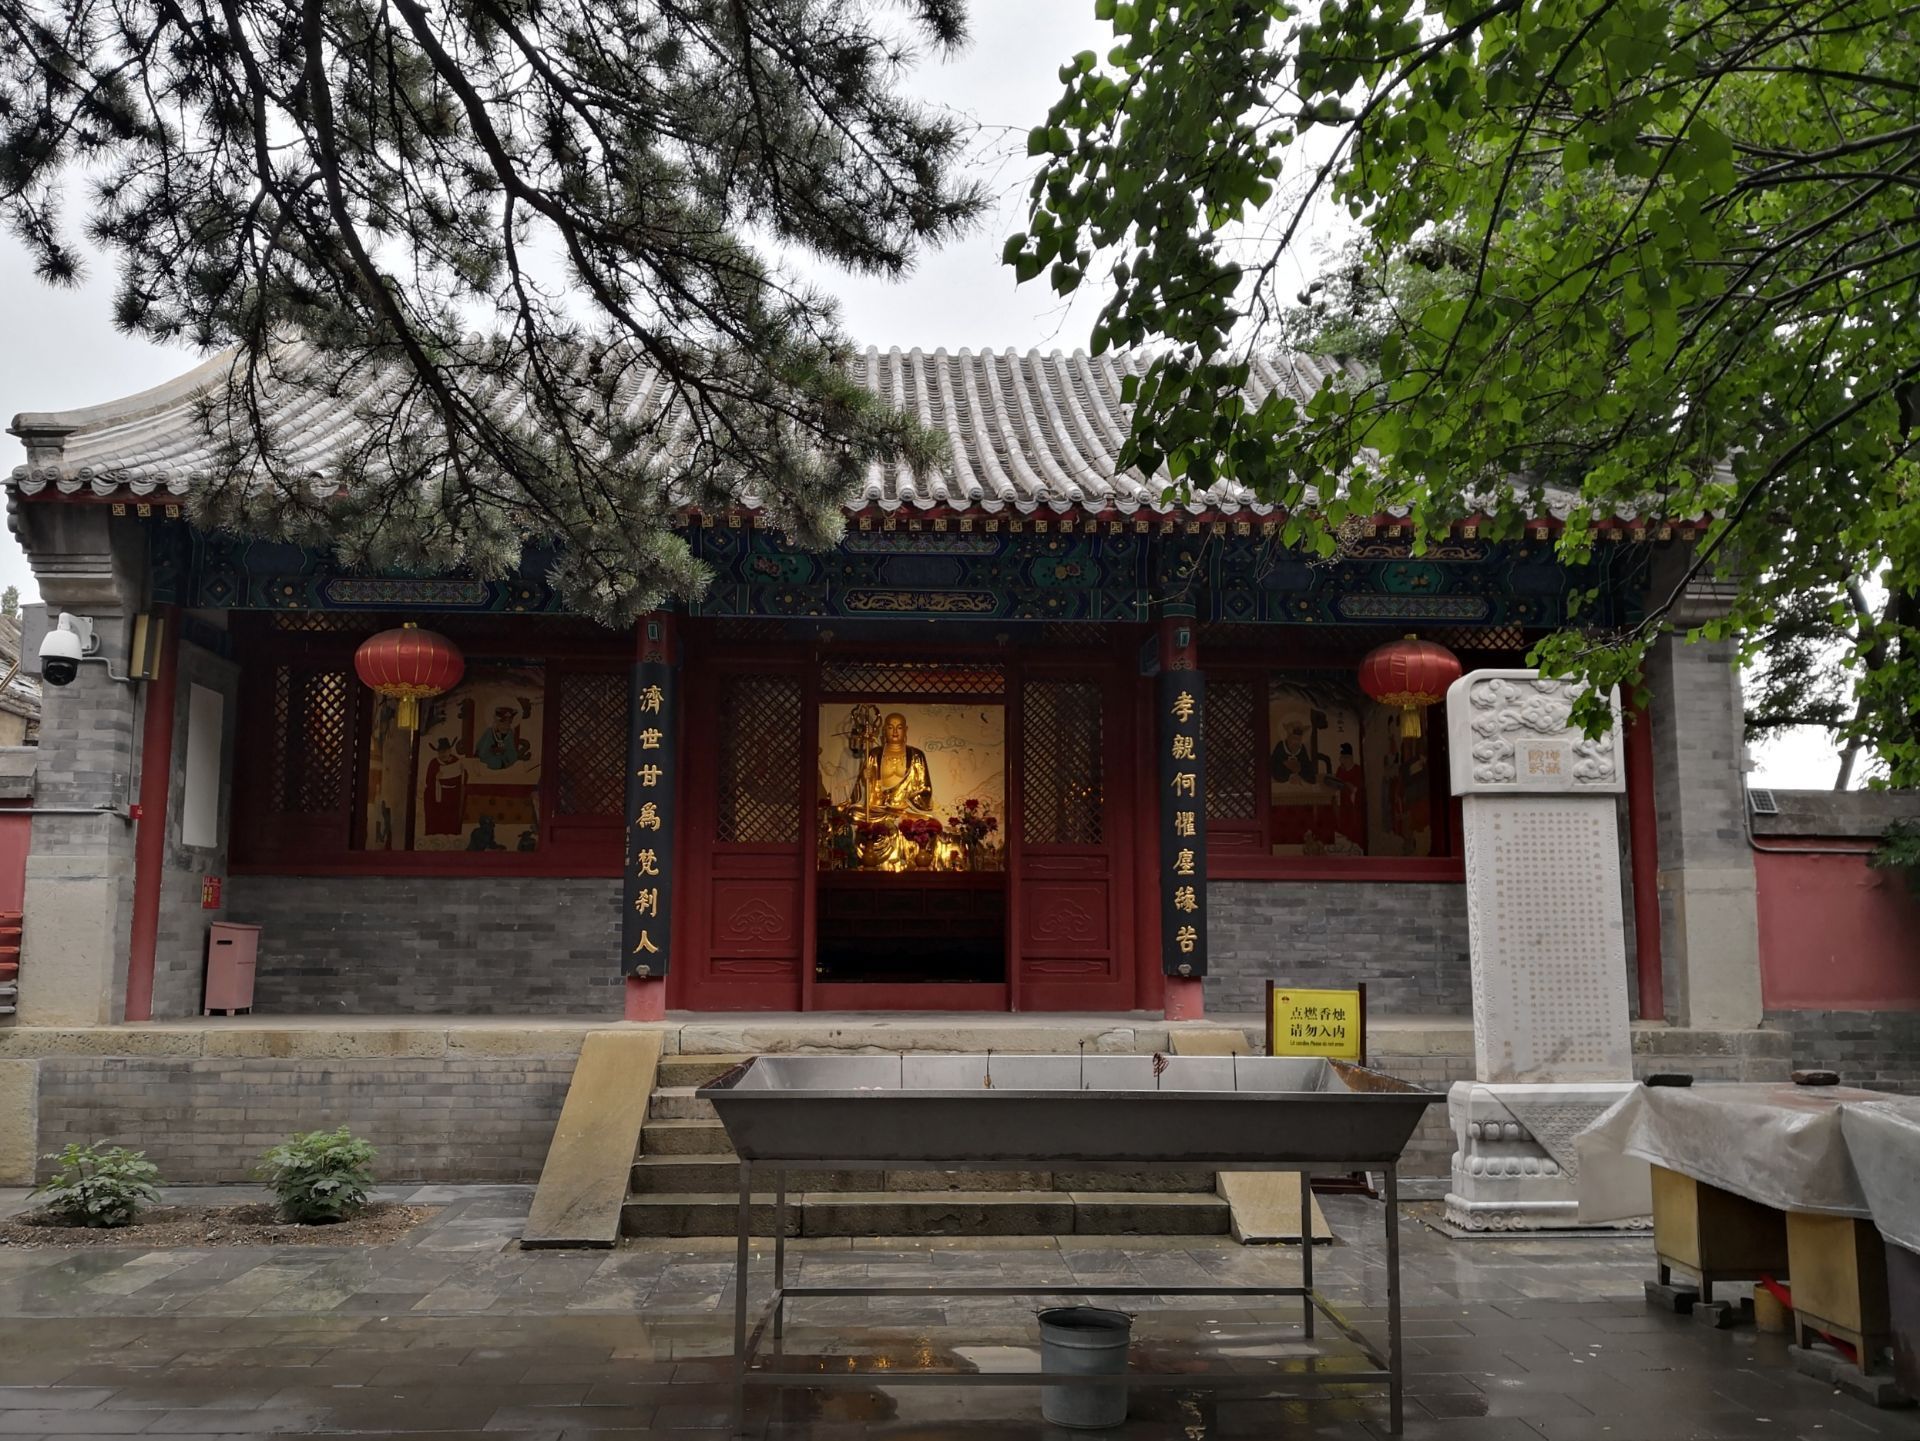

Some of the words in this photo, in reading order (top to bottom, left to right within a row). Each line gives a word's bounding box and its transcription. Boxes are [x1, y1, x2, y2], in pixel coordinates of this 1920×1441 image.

[1290, 1006, 1346, 1021] 点燃香烛
[1290, 1023, 1345, 1038] 请勿入内
